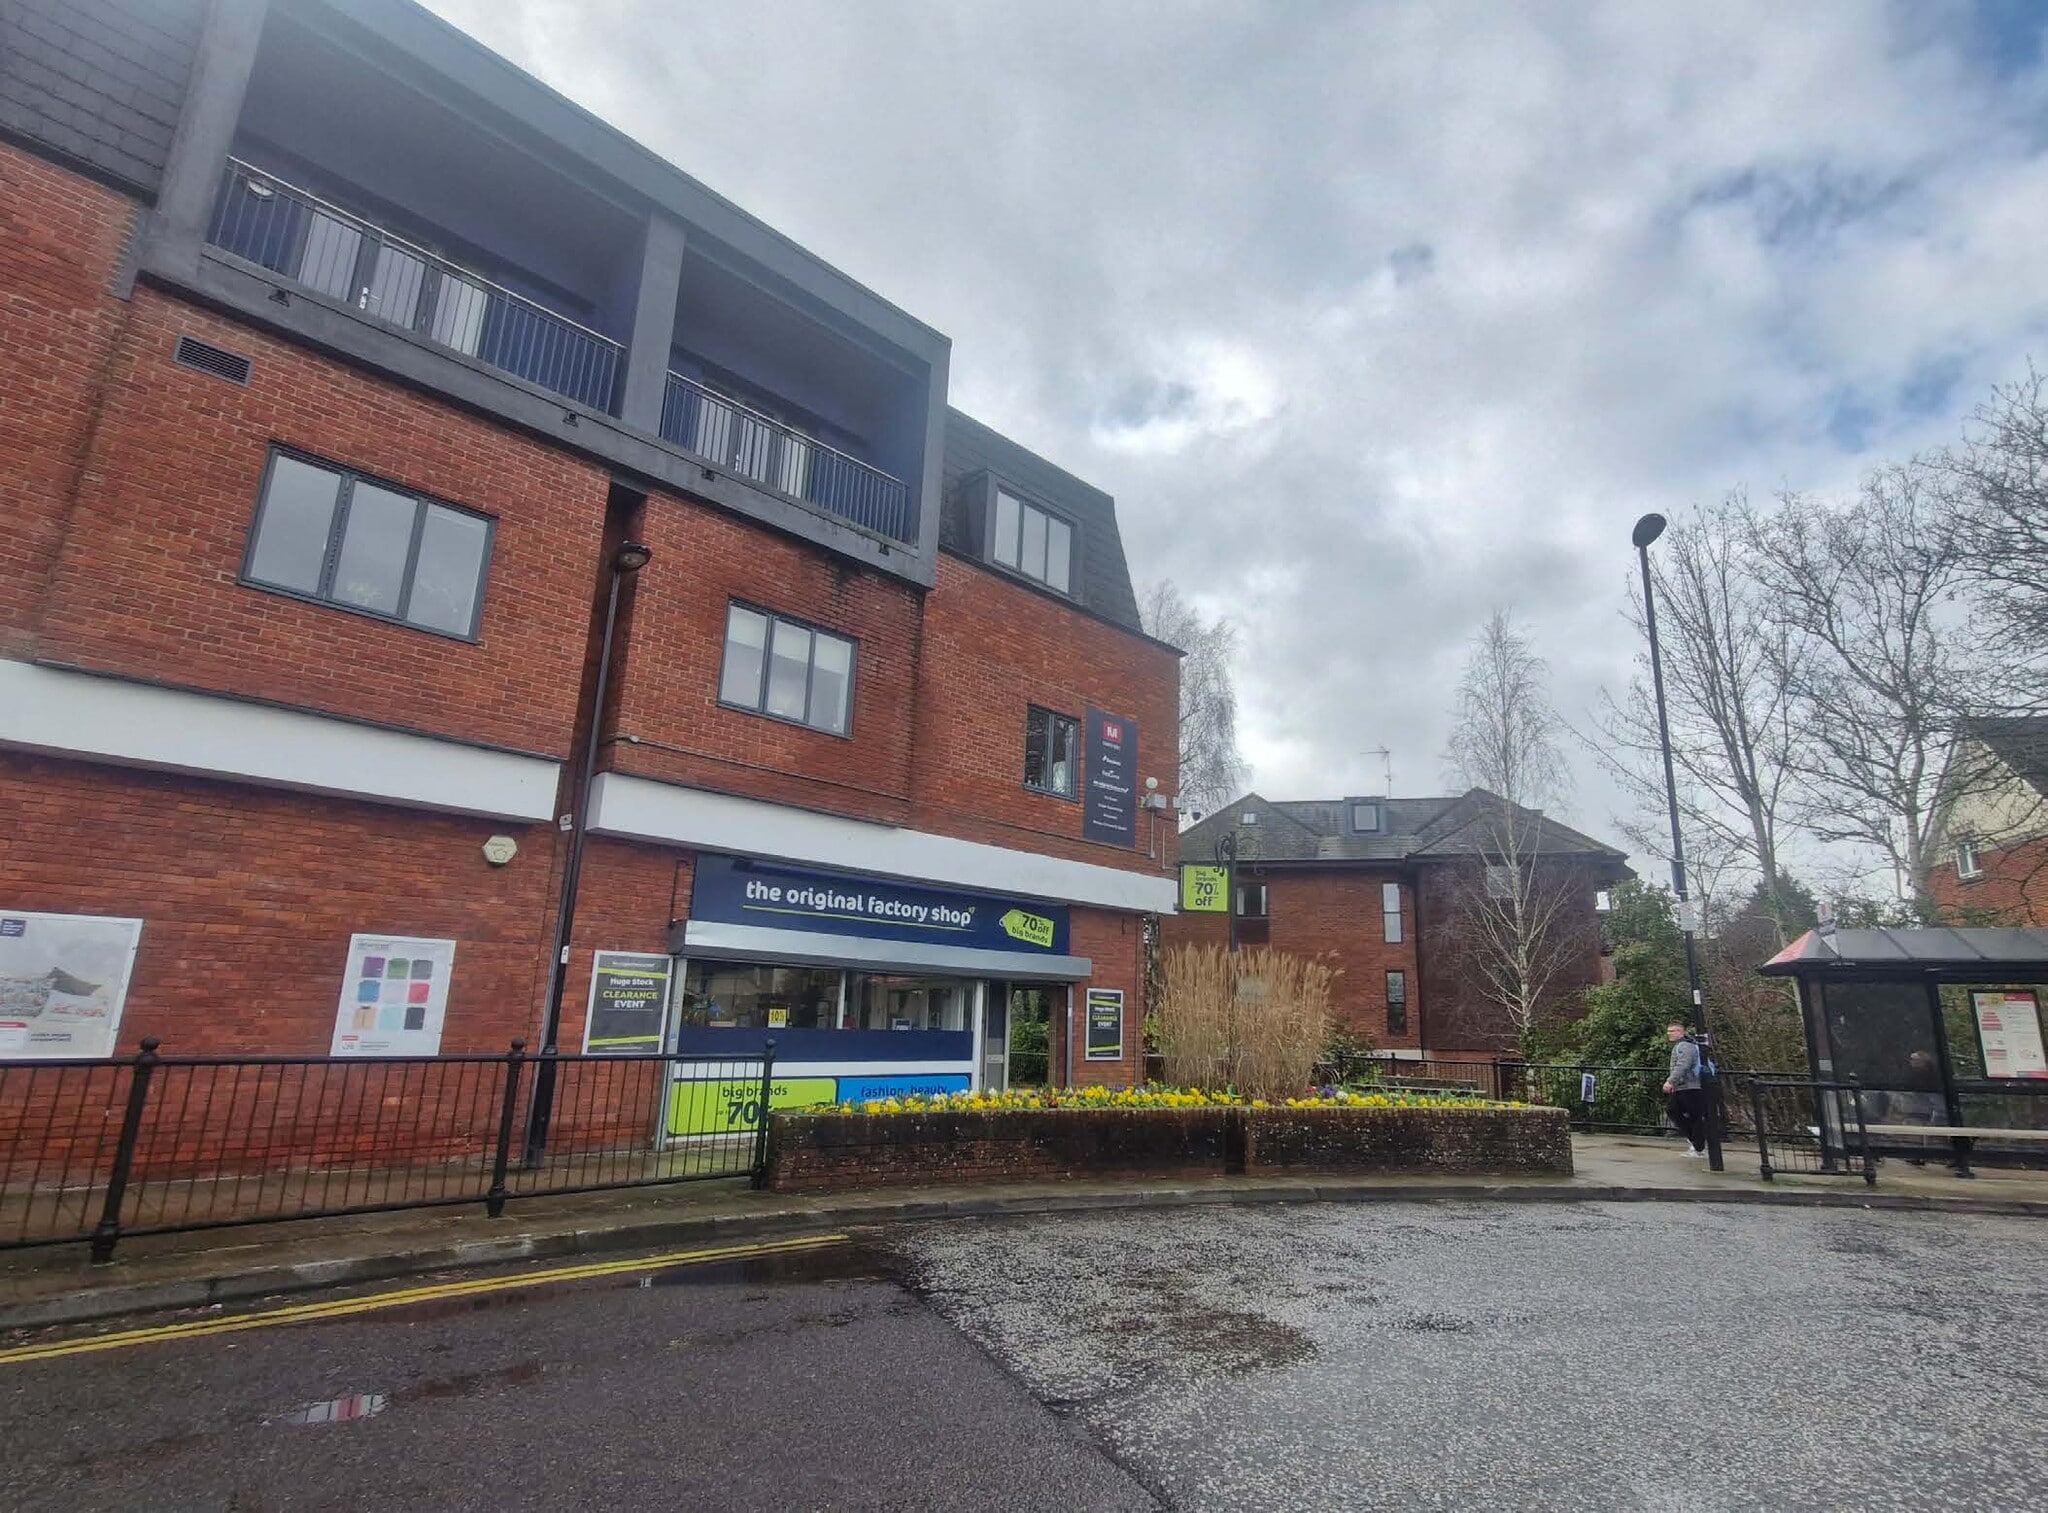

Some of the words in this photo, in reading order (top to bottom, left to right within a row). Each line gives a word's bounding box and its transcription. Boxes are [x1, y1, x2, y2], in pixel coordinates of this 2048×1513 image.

[746, 881, 781, 901] the
[786, 887, 864, 911] original
[868, 896, 928, 922] factory
[931, 905, 972, 927] shop
[1195, 896, 1212, 906] off
[1011, 926, 1024, 937] big
[1037, 925, 1049, 935] off
[610, 977, 631, 987] Huge
[631, 978, 654, 986] Stock
[602, 990, 659, 1000] CLEARANCE
[613, 1000, 646, 1009] EVENT
[722, 1086, 743, 1100] big
